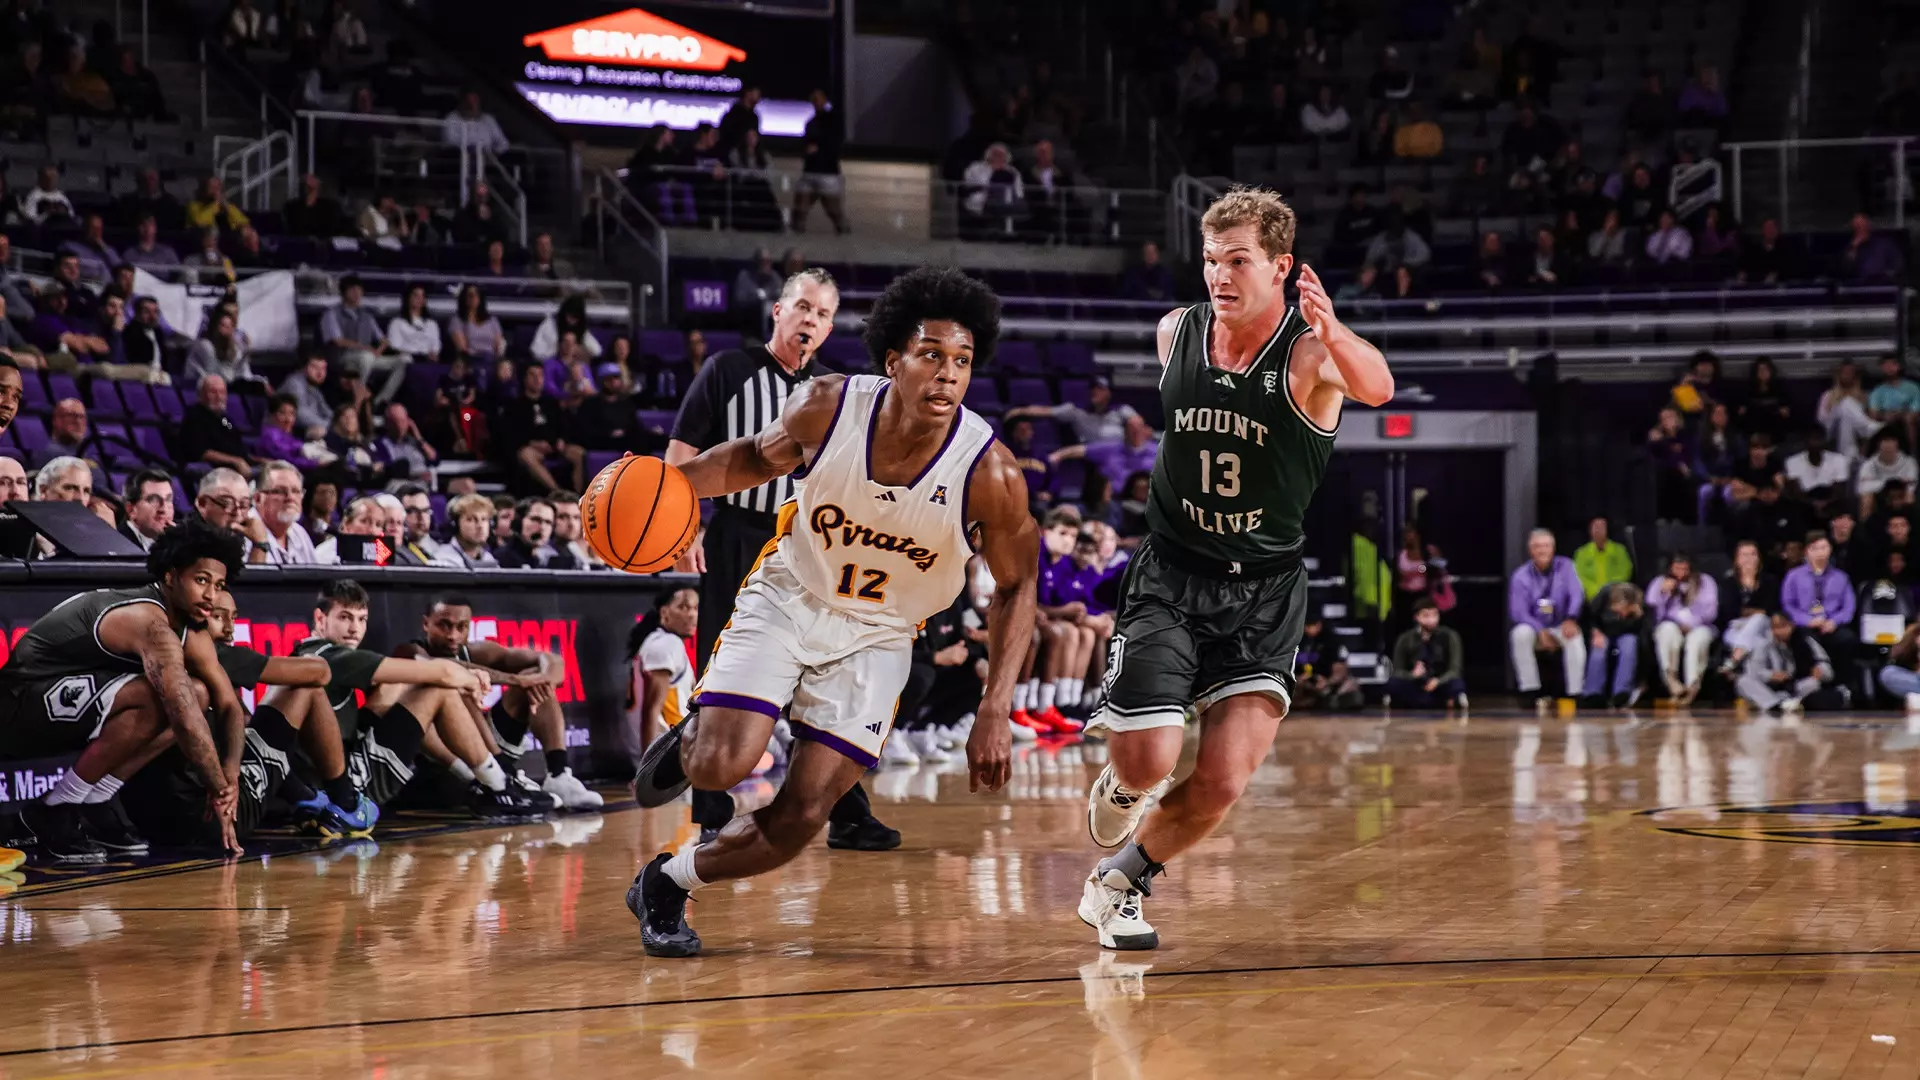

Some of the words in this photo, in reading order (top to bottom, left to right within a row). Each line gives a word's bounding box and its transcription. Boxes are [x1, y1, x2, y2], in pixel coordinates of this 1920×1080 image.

[572, 28, 701, 62] SERVPRO
[692, 286, 721, 307] 101
[1174, 407, 1268, 447] MOUNT
[1199, 449, 1241, 497] 13
[1182, 498, 1263, 535] OLIVE
[810, 503, 939, 573] Pirates
[836, 563, 890, 604] 12
